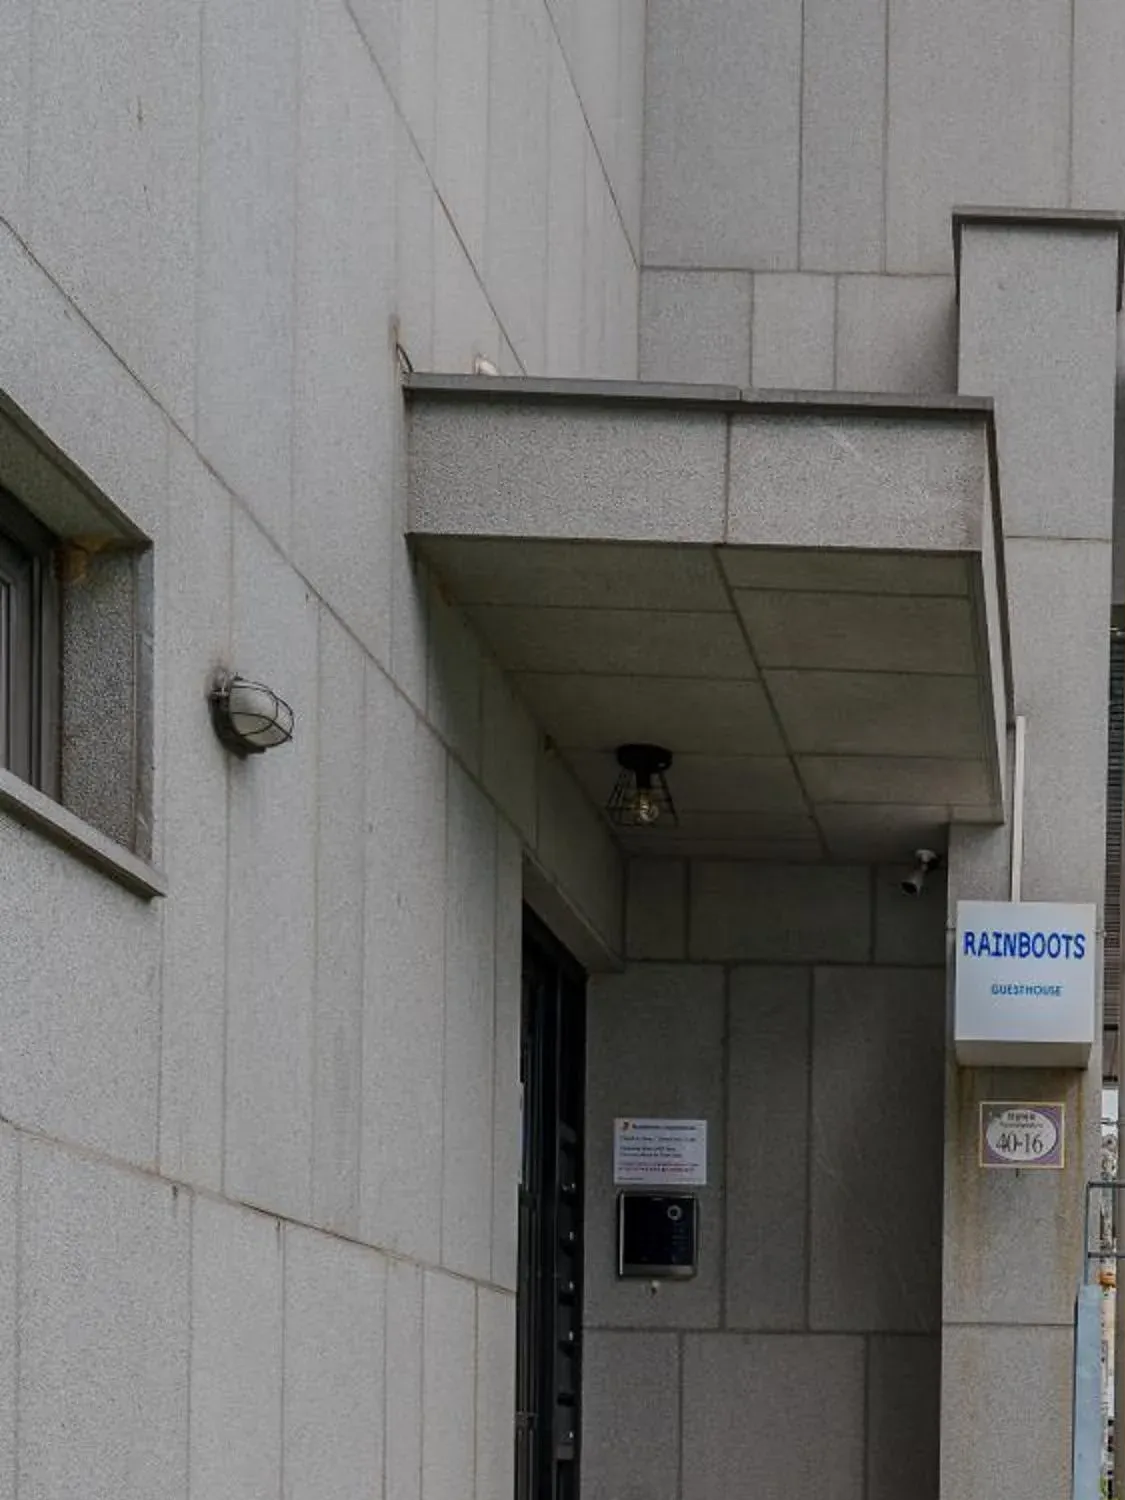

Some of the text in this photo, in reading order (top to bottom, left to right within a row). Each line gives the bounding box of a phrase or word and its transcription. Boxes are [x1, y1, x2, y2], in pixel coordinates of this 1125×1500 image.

[963, 931, 1086, 960] RAINBOOTS
[991, 984, 1063, 997] GUESTHOUSE
[996, 1132, 1044, 1153] 40-16
